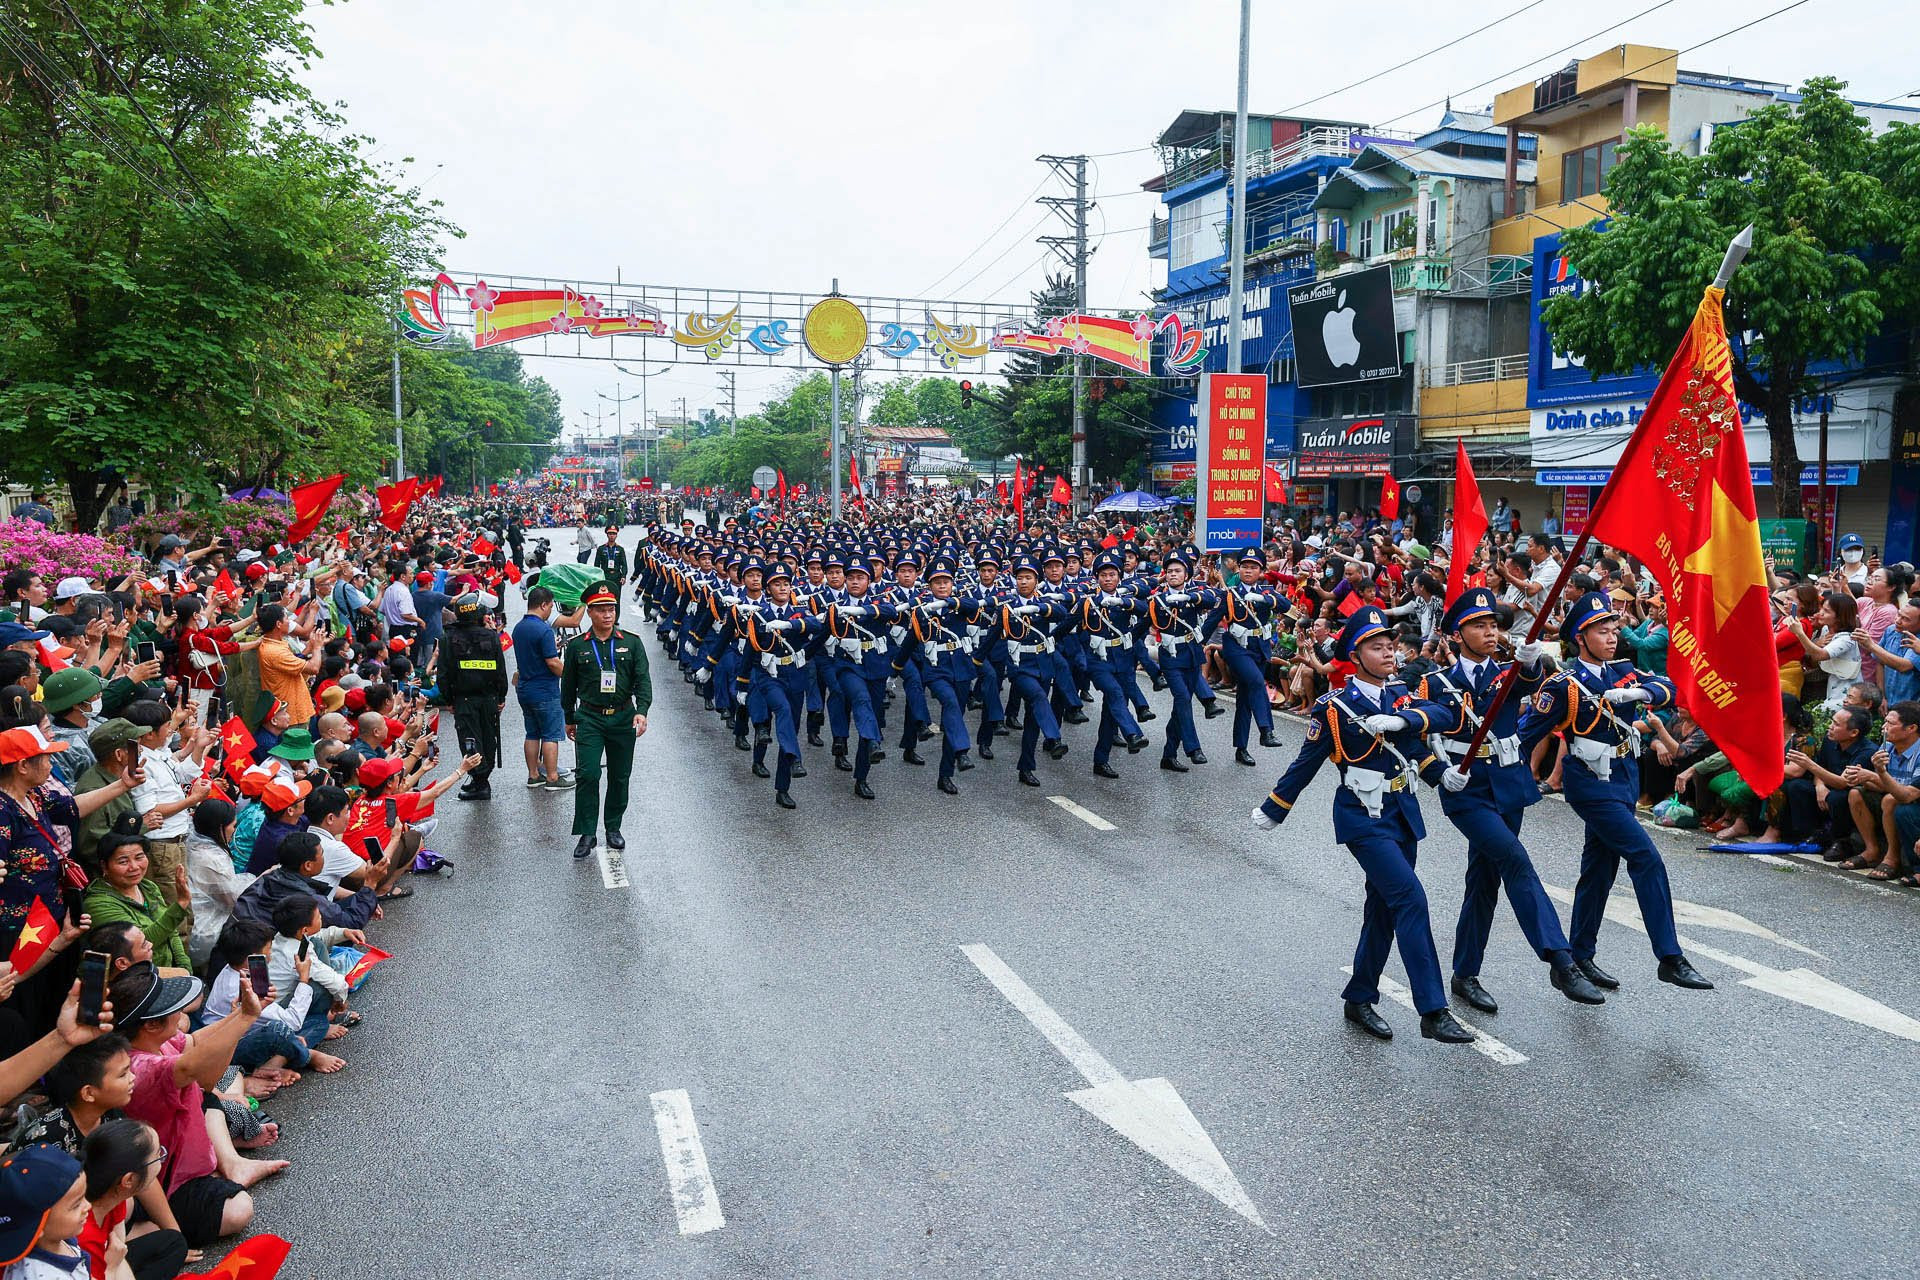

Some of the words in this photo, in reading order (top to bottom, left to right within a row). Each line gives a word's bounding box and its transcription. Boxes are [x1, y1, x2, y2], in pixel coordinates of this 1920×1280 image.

[1549, 286, 1560, 296] FPT
[1560, 282, 1577, 293] Retail
[1546, 408, 1587, 431] Dành
[1590, 408, 1624, 428] cho
[1302, 428, 1336, 448] Tuấn
[1339, 422, 1391, 446] Mobile
[1208, 528, 1259, 540] mobifone
[1655, 532, 1672, 559] BỘ
[1697, 671, 1738, 709] BIỂN
